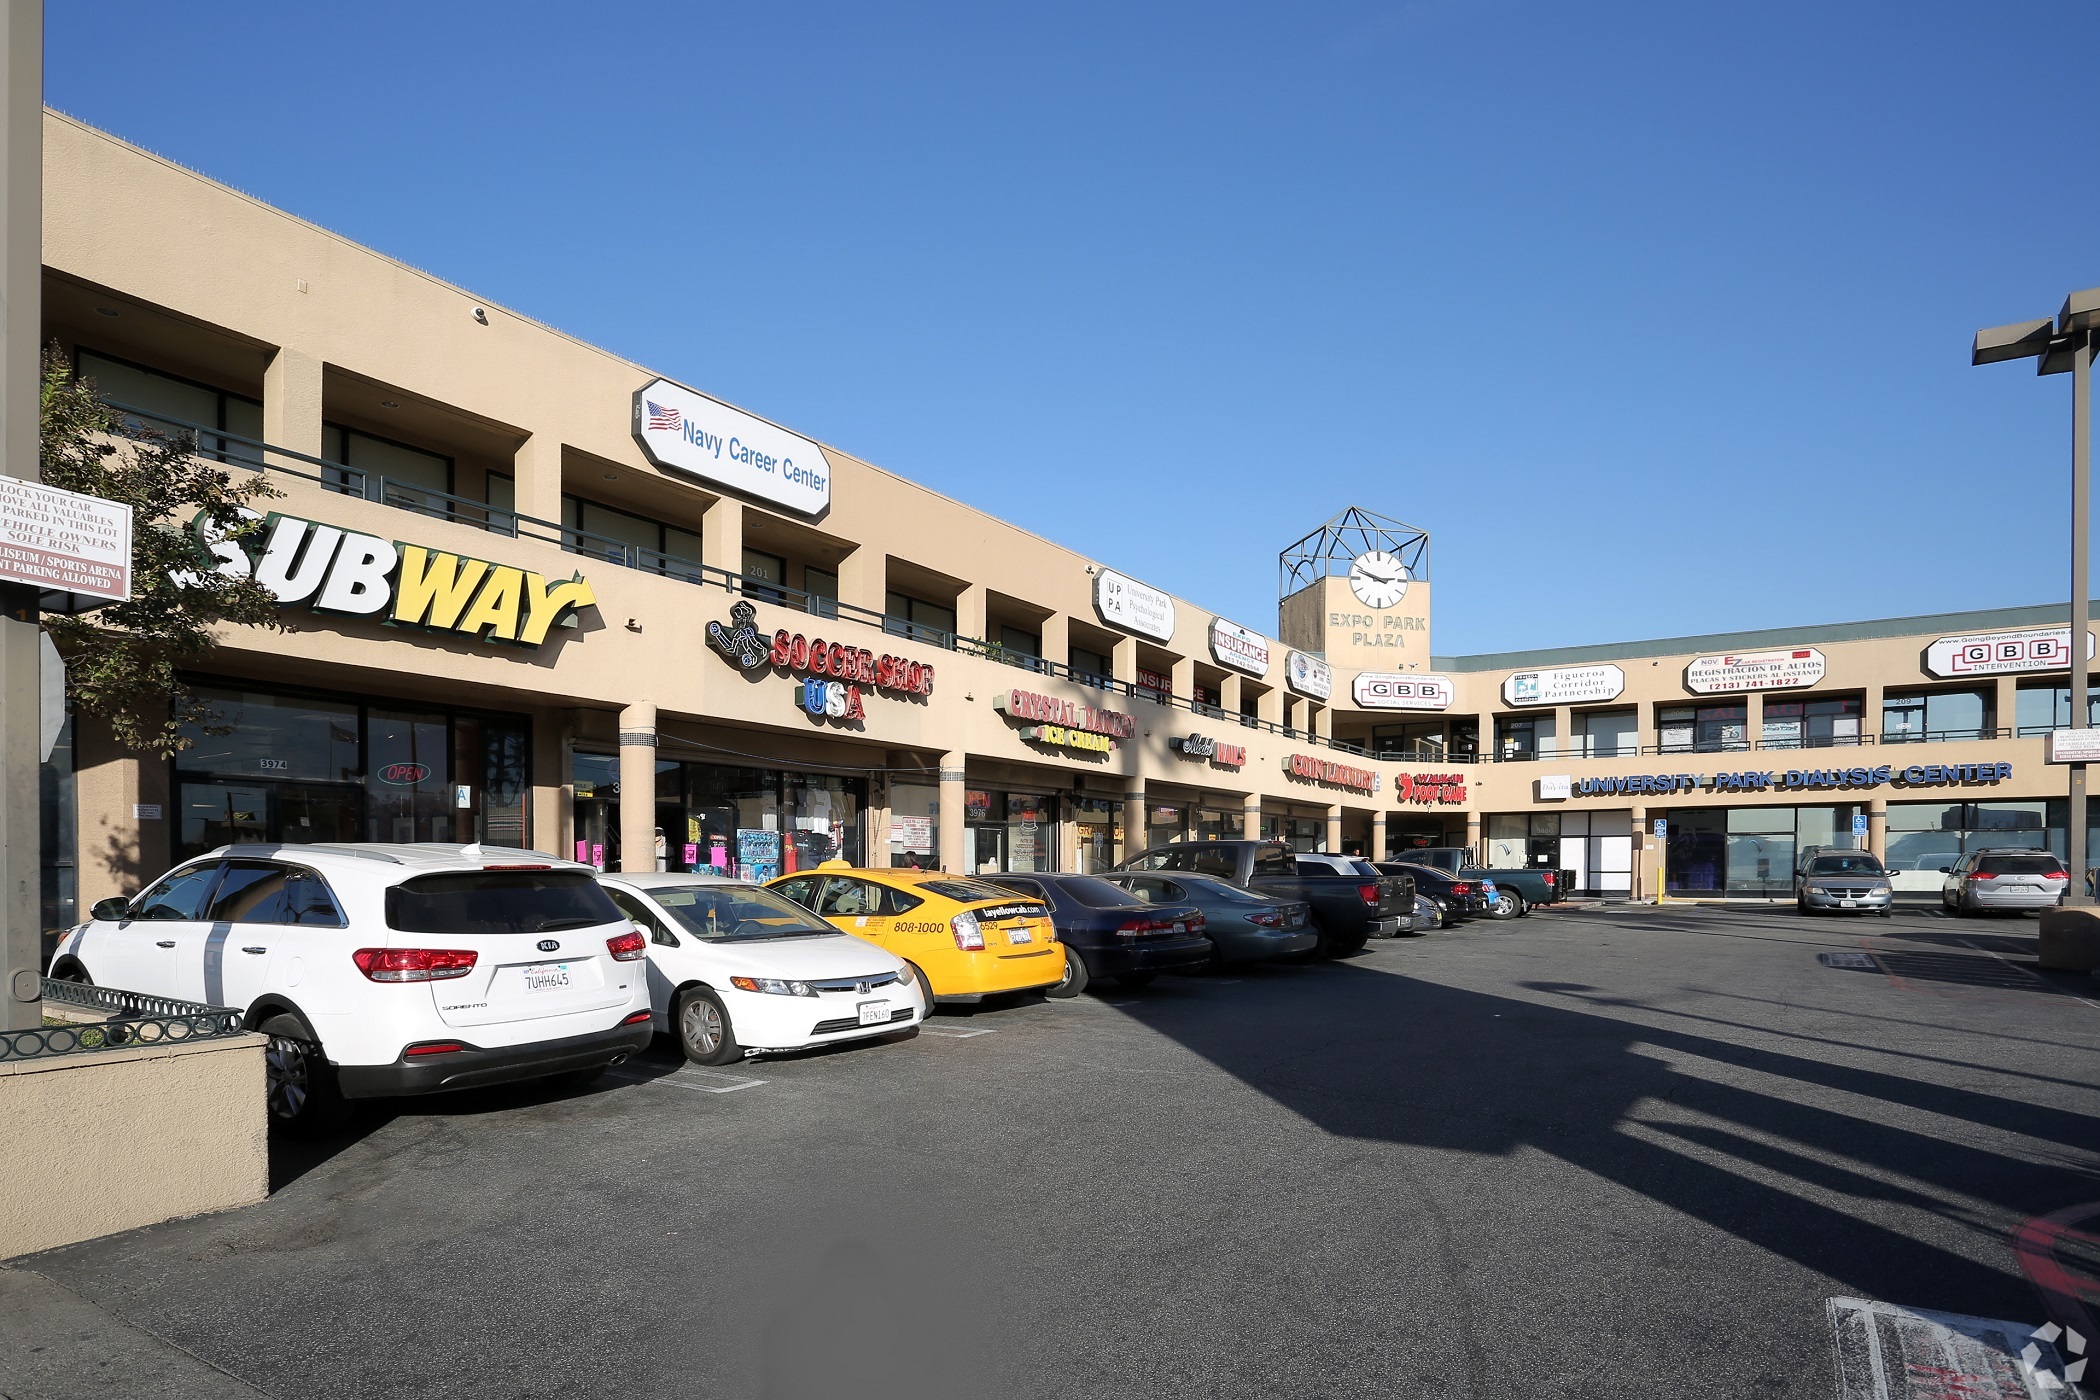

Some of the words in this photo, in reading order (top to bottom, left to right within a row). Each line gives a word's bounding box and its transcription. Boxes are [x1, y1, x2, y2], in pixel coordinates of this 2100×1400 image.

[683, 418, 723, 458] Navy
[729, 437, 777, 474] Career
[783, 458, 826, 492] Center
[0, 484, 32, 498] LOCK
[35, 492, 67, 506] YOUR
[70, 502, 91, 512] CAR
[3, 505, 49, 523] PARKED
[52, 516, 65, 526] IN
[68, 520, 95, 532] THIS
[97, 526, 119, 538] LOT
[30, 501, 51, 513] ALL
[53, 507, 114, 527] VALUABLES
[0, 518, 55, 537] EHICLE
[60, 531, 117, 550] OWNERS
[8, 531, 44, 545] SOLE
[48, 539, 80, 553] RISK
[13, 561, 60, 579] PARKING
[61, 572, 111, 589] ALLOWED
[46, 555, 88, 572] SPORTS
[88, 564, 121, 579] ARENA
[750, 565, 769, 580] 201
[167, 506, 596, 645] SUBWAY
[1127, 584, 1154, 605] University
[1155, 596, 1167, 609] Park
[1129, 599, 1165, 621] Psychological
[1134, 615, 1161, 633] Associates
[1329, 613, 1374, 628] EXPO
[1383, 615, 1426, 630] PARK
[1232, 632, 1251, 642] EXPO
[1352, 632, 1405, 648] PLAZA
[1215, 630, 1267, 663] INSURANCE
[770, 628, 875, 684] SOCCER
[875, 653, 935, 696] SHOP
[1230, 651, 1254, 664] AGENCY
[1787, 661, 1822, 669] AUTOS
[1973, 660, 2046, 671] INTERVENTION
[1553, 670, 1605, 681] Figueroa
[1729, 673, 1768, 681] STICKERS
[1783, 669, 1822, 677] INSTANTE
[1745, 678, 1799, 688] 741-1822
[1553, 679, 1605, 689] Corridor
[803, 677, 866, 720] USA
[1545, 687, 1615, 698] Partnership
[1008, 688, 1078, 728] CRYSTAL
[1081, 706, 1137, 739] BAKERY
[1042, 725, 1065, 745] ICE
[1068, 730, 1110, 752] CREAM
[1216, 742, 1246, 766] NAILS
[261, 760, 287, 769] 3974
[387, 765, 423, 780] OPEN
[1292, 754, 1324, 779] COIN
[1326, 762, 1375, 790] LAUNDRY
[1580, 773, 1704, 793] UNIVERSITY
[1716, 770, 1774, 787] PARK
[1787, 766, 1891, 787] DIALYSIS
[1905, 762, 2013, 784] CENTER
[1414, 786, 1439, 801] FOOT
[1442, 786, 1467, 801] CARE
[1542, 782, 1569, 791] DaVita
[965, 791, 990, 807] OPEN
[969, 809, 986, 817] 3976
[1078, 824, 1108, 836] GRAND
[983, 905, 1040, 918] layellowcab.com
[894, 922, 944, 933] 808-1000
[980, 922, 998, 931] 6529
[540, 942, 558, 950] KIA
[525, 973, 569, 989] 7UHH645
[442, 1002, 488, 1011] SORENTO
